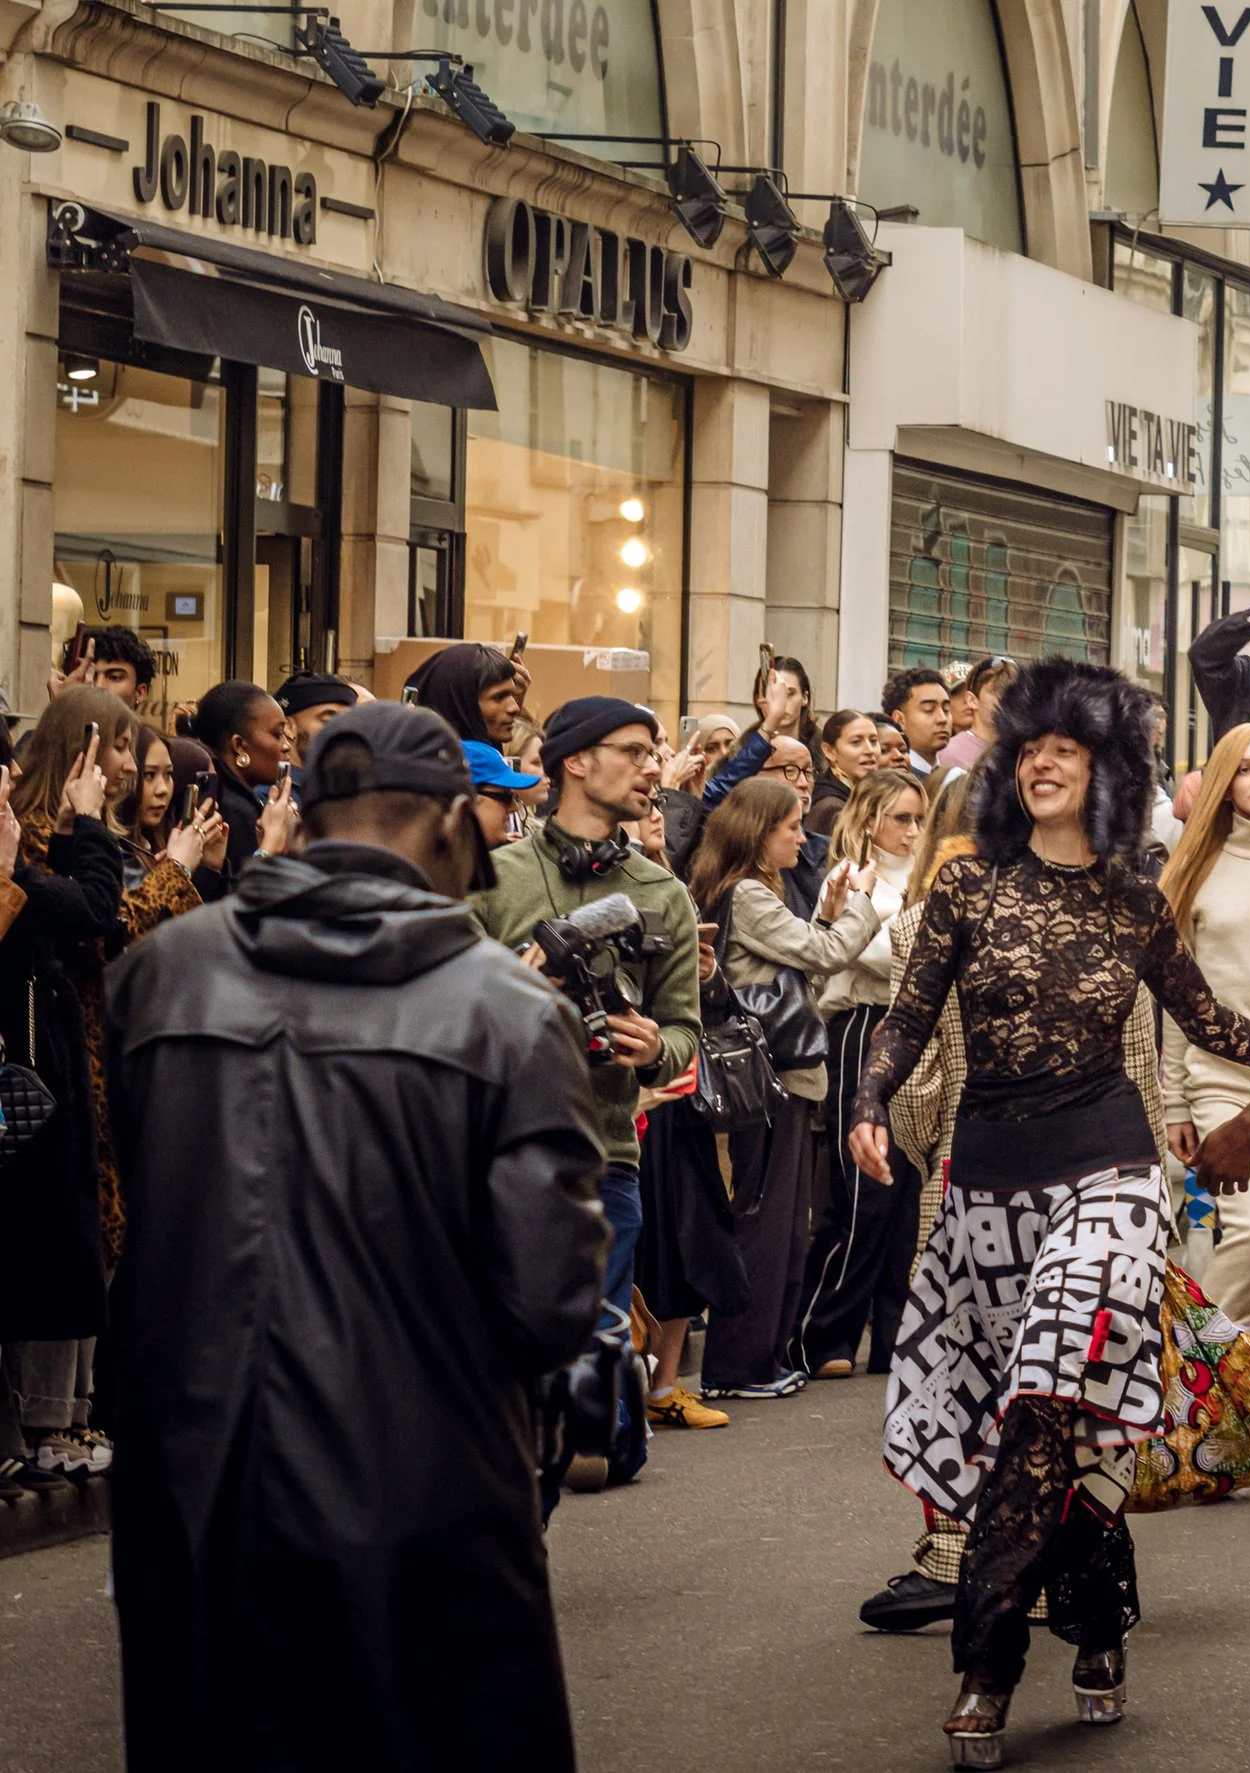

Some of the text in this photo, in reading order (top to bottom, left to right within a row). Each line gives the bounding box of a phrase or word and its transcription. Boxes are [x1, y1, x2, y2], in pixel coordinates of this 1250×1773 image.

[133, 101, 317, 245] Johanna
[1105, 400, 1138, 467] VIE
[1139, 410, 1164, 476] TA
[1165, 417, 1196, 484] VIE
